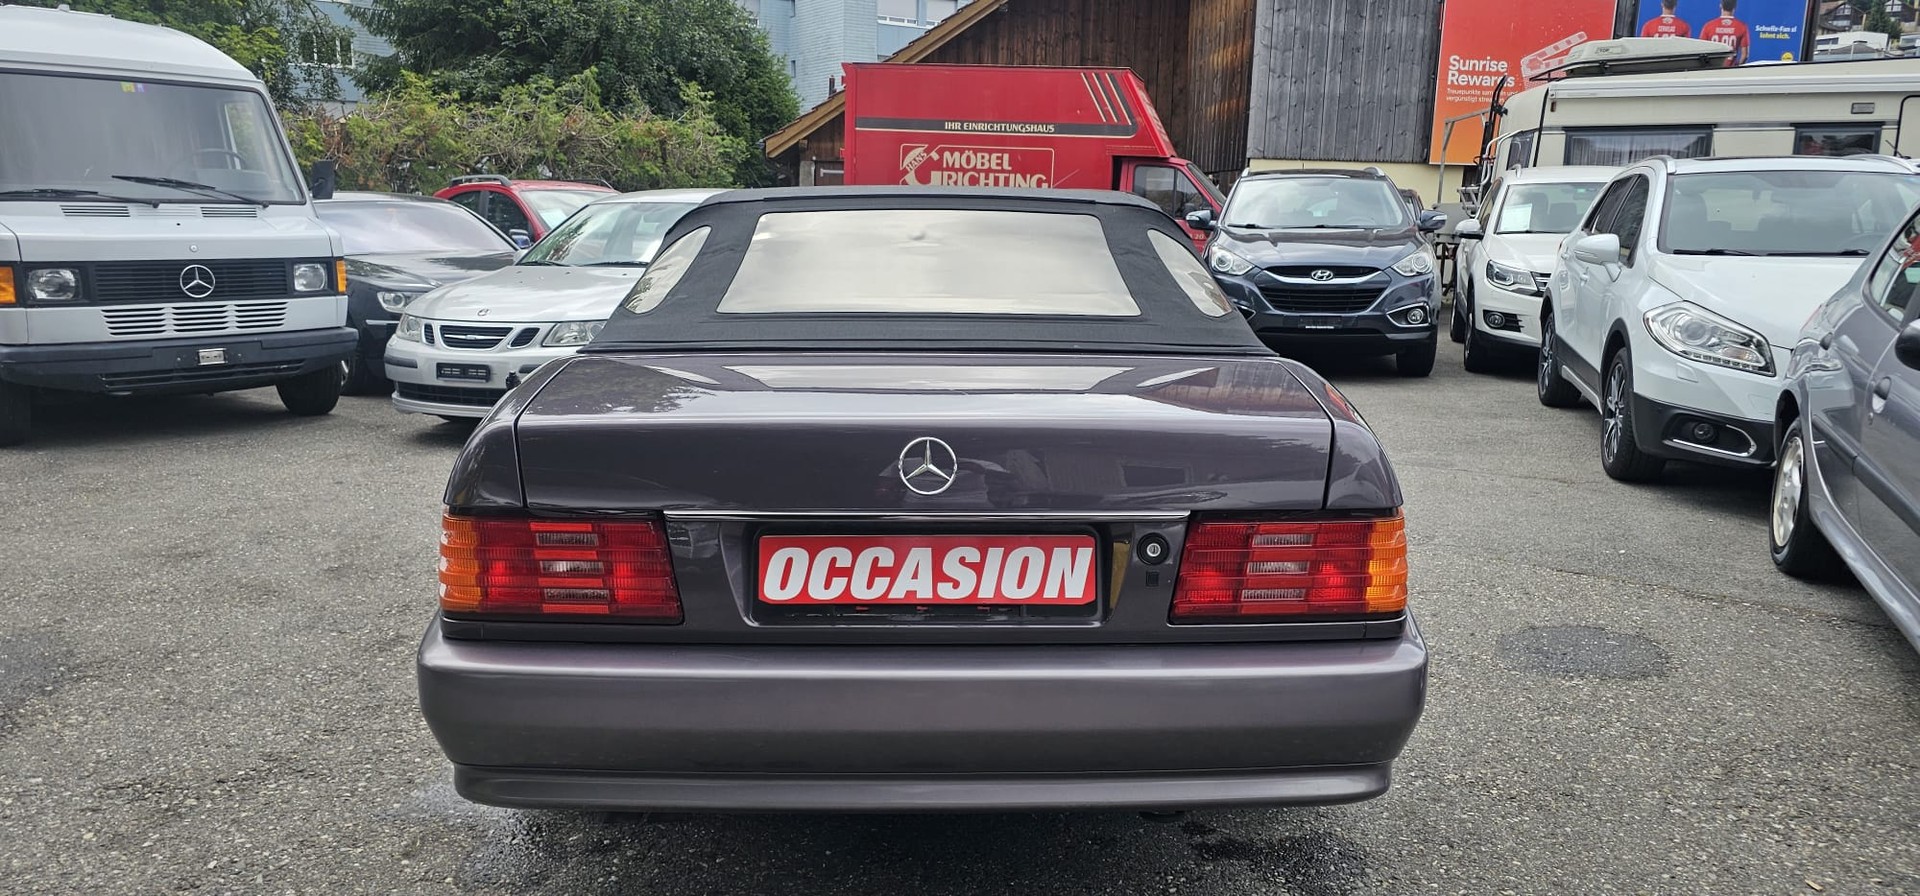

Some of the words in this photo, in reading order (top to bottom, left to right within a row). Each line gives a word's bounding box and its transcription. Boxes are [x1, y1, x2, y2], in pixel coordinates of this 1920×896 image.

[1448, 55, 1507, 72] Sunrise
[944, 121, 961, 131] IHR
[963, 122, 1054, 133] EINRICHTUNGSHAUS
[906, 151, 927, 171] HANS
[943, 150, 1012, 170] MÖBEL
[763, 546, 1092, 600] OCCASION
